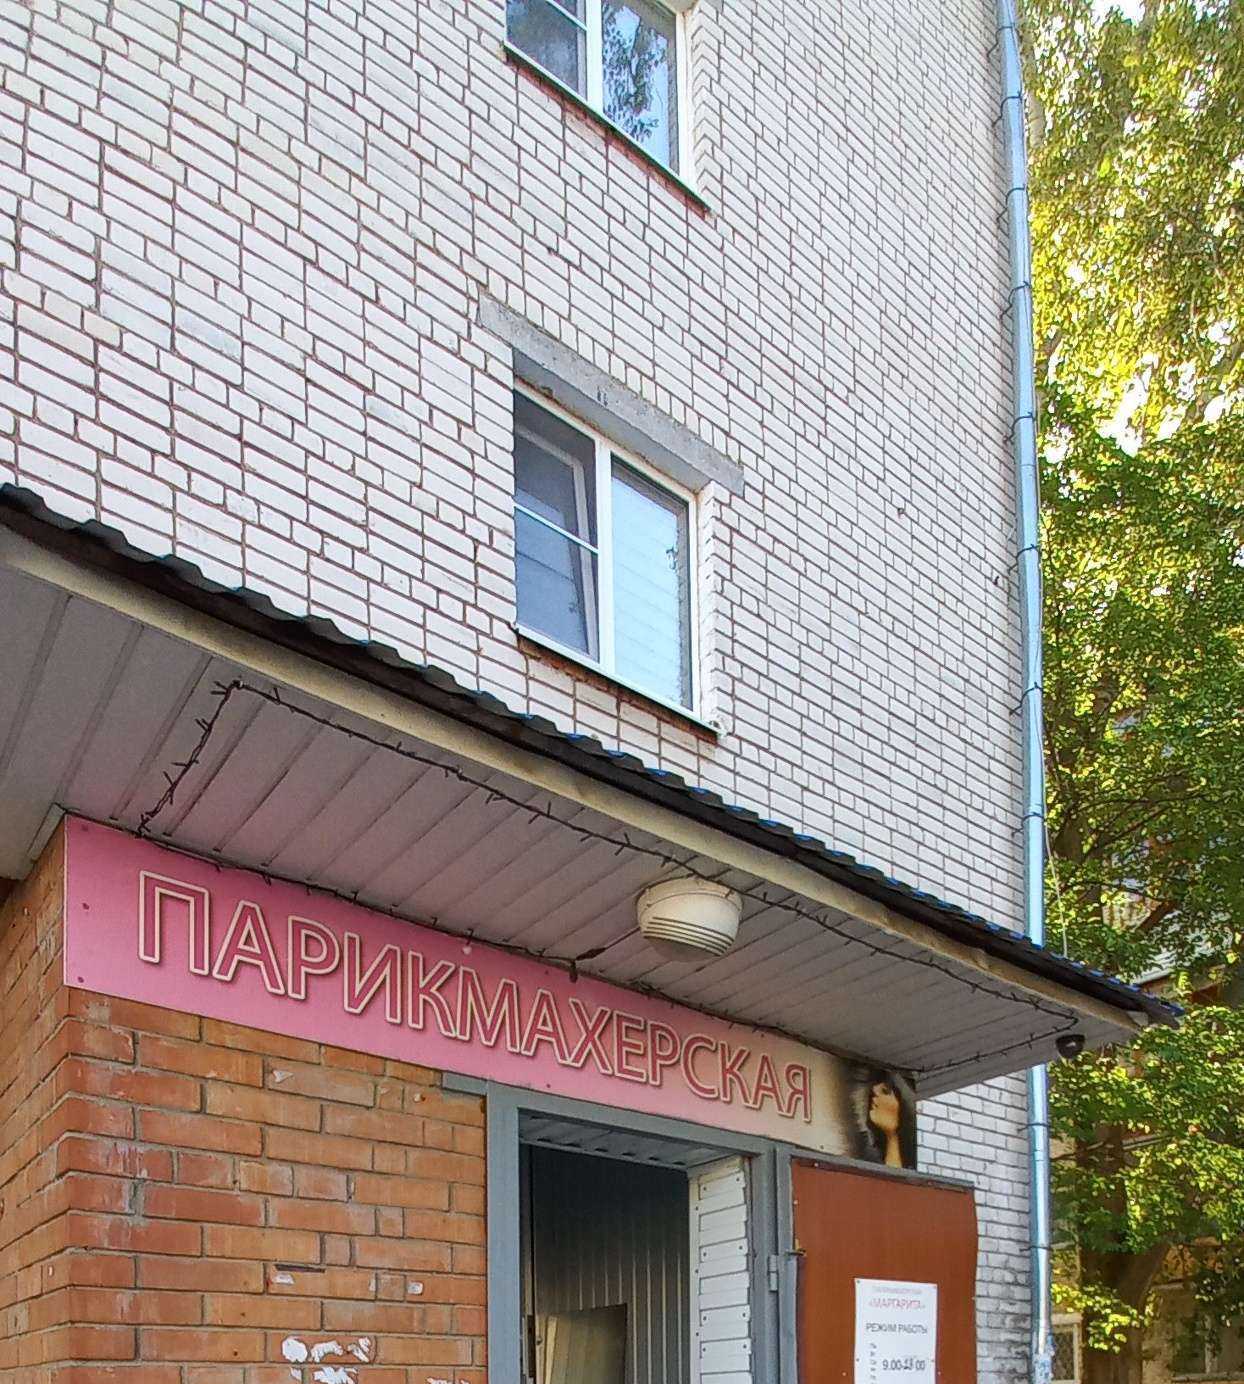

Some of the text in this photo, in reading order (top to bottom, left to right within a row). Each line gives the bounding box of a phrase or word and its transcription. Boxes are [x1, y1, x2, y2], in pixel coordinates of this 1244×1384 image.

[137, 869, 813, 1124] ПАРИКМАХЕРСКАЯ
[866, 1322, 928, 1335] РЕЖИМ РАБОТЫ
